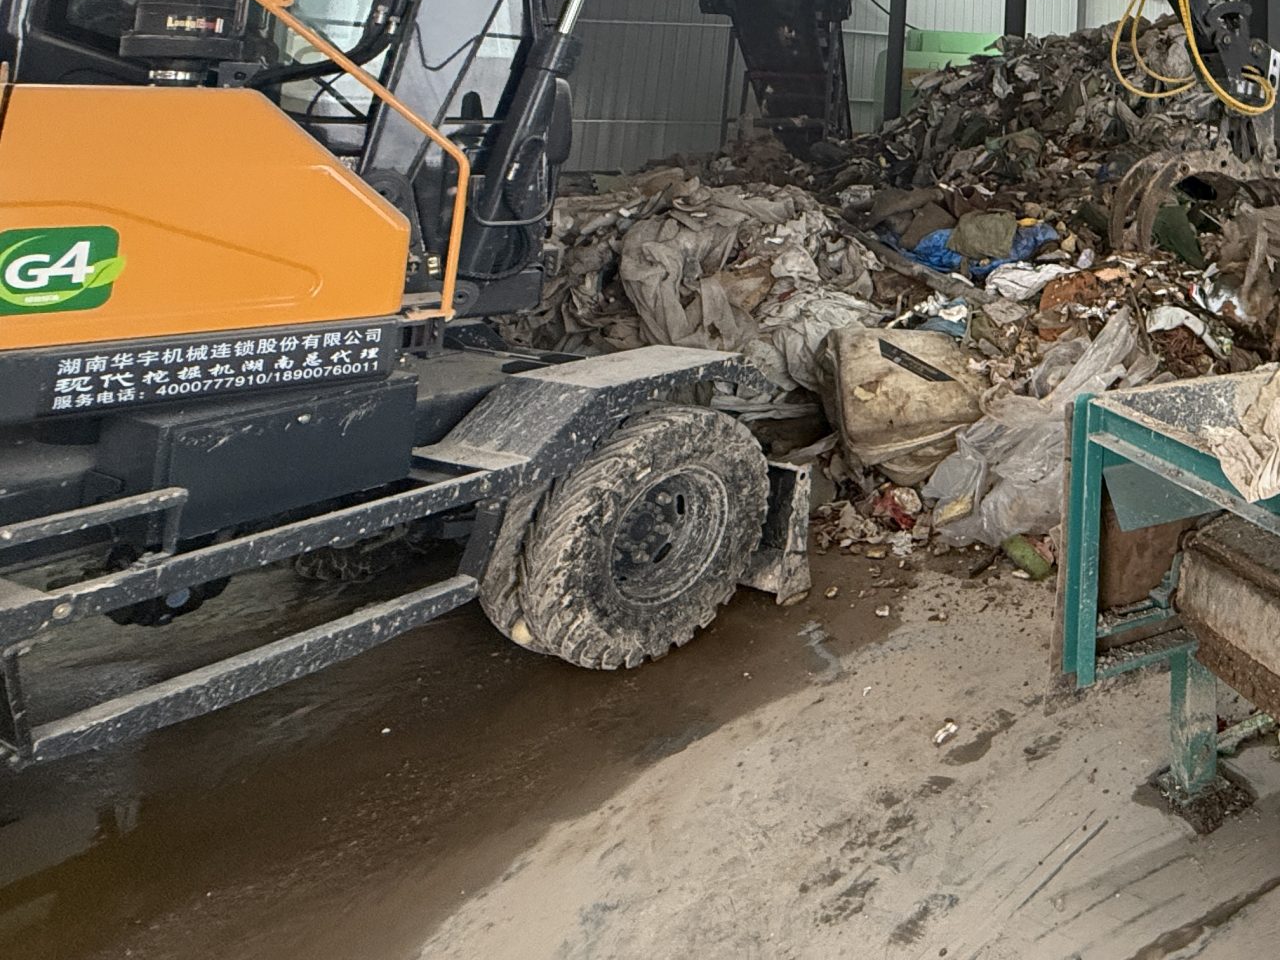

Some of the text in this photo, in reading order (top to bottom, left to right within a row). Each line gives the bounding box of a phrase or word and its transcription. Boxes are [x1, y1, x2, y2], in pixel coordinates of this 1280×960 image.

[4, 241, 95, 289] G4
[54, 347, 380, 393] 现代挖掘机湖南总代理
[57, 328, 382, 376] 湖南华宇机械连锁股份有限公司
